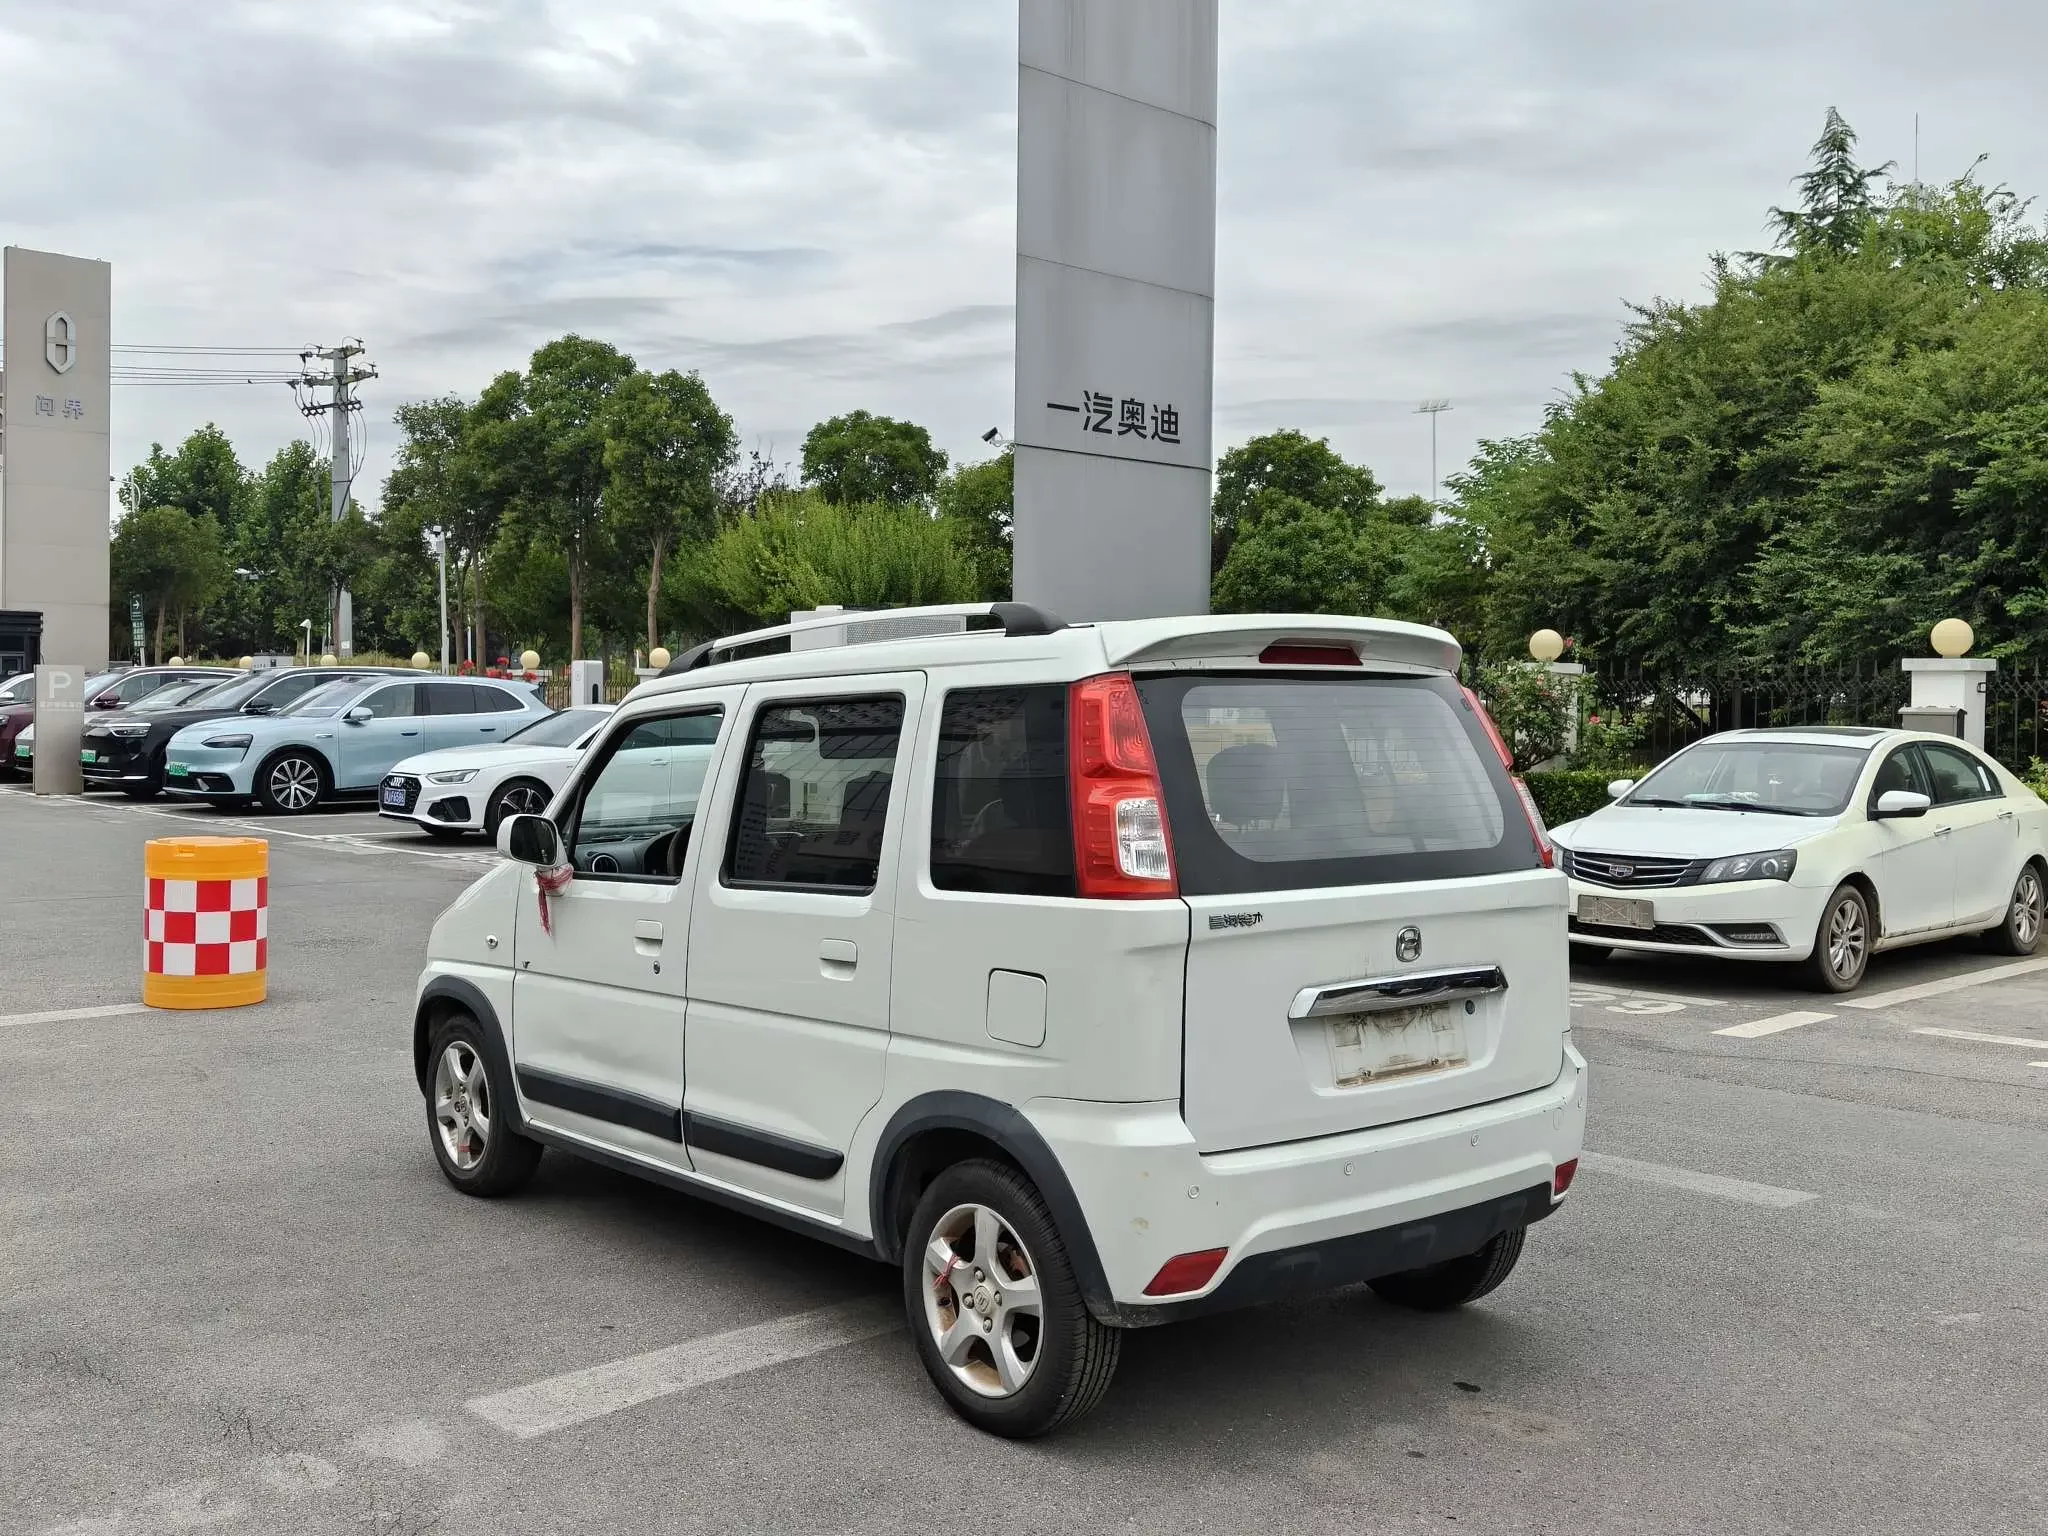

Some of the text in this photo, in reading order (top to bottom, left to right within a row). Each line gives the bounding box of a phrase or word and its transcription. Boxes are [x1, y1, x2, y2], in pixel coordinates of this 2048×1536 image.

[1047, 390, 1181, 444] 一汽奥迪
[49, 671, 72, 699] P
